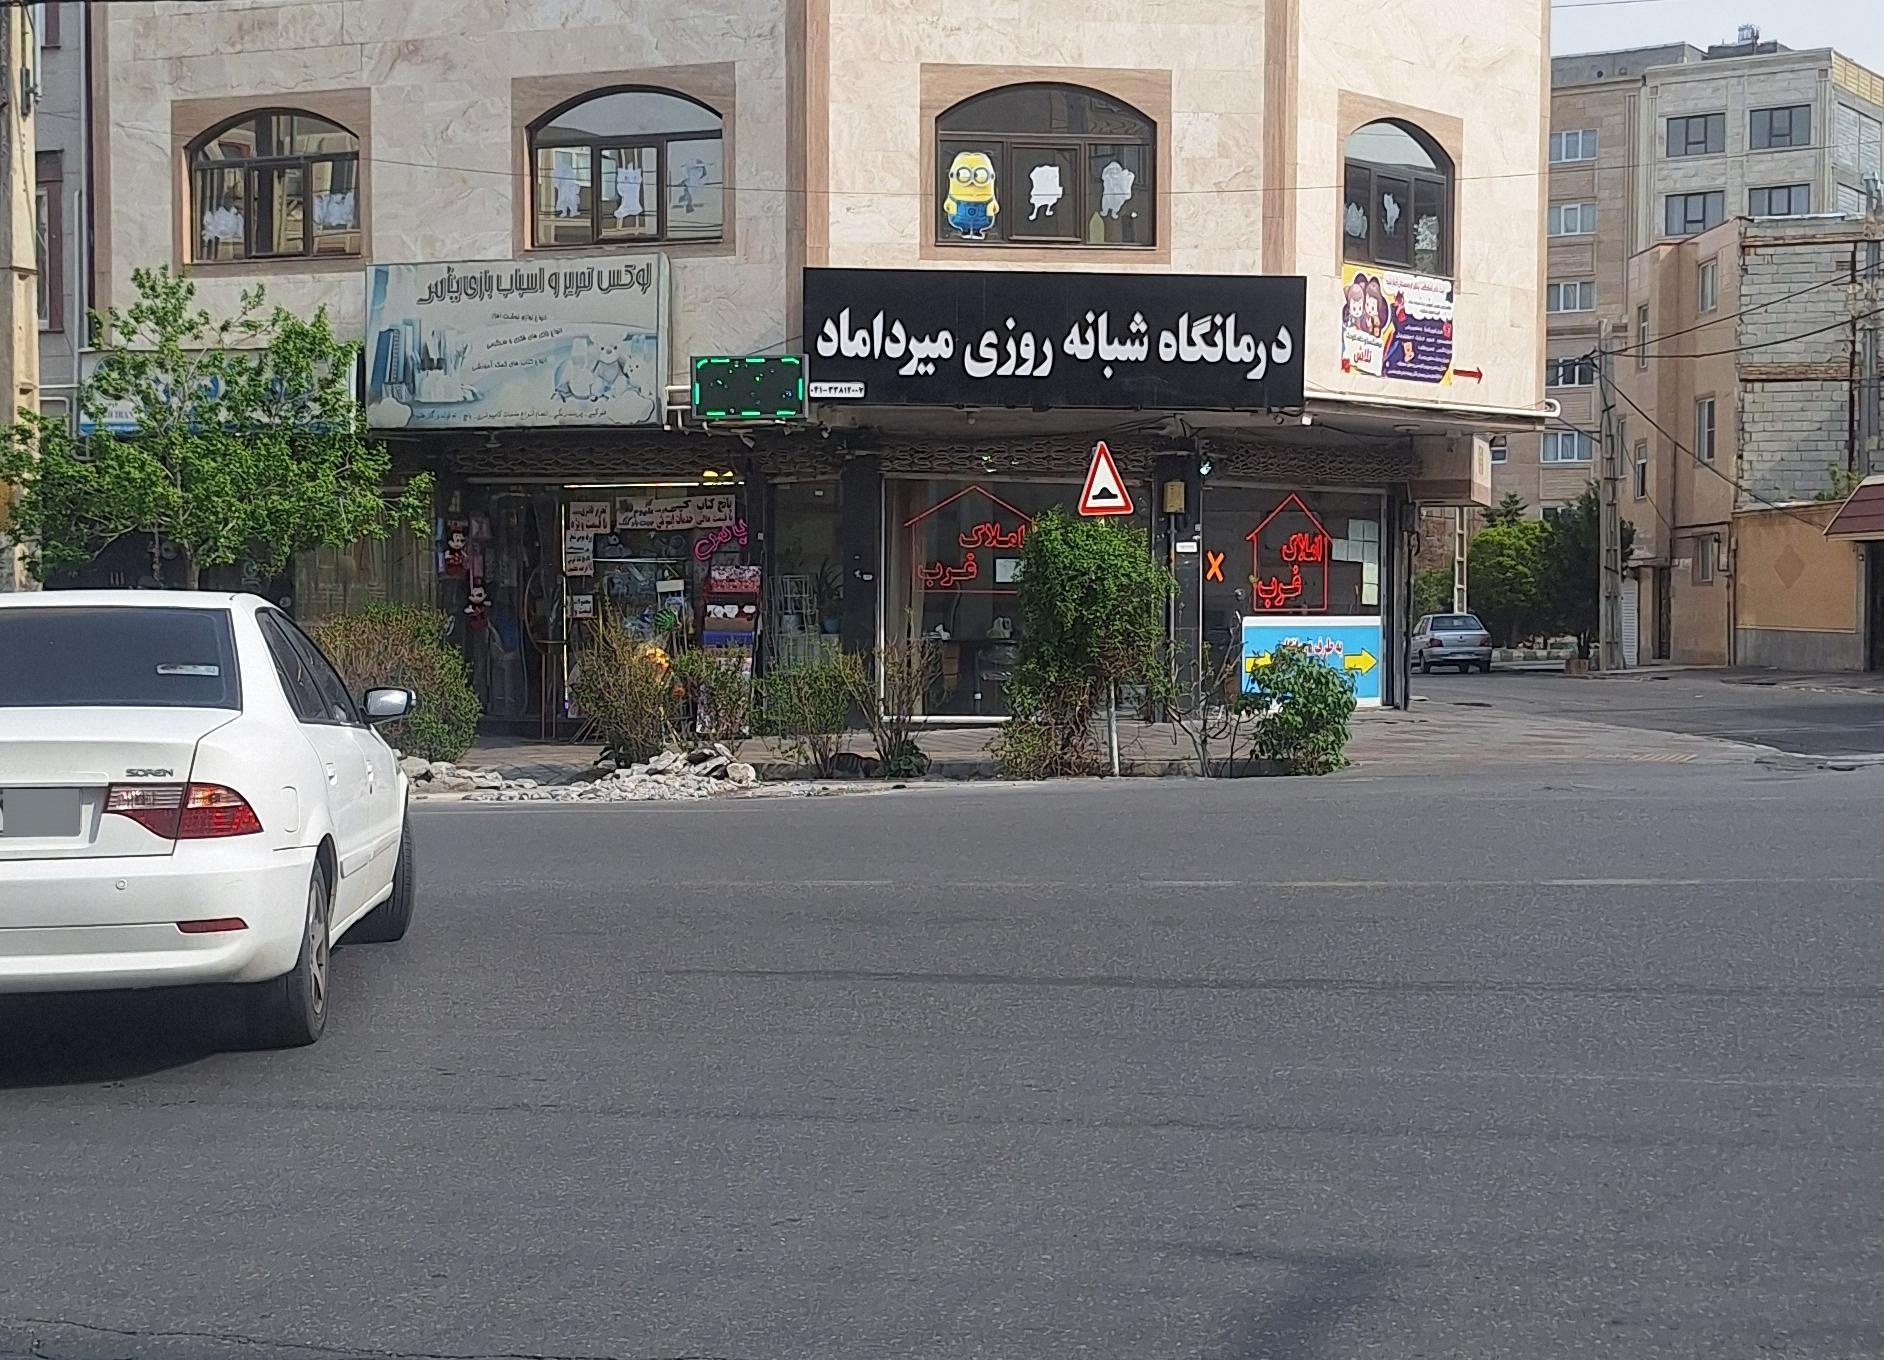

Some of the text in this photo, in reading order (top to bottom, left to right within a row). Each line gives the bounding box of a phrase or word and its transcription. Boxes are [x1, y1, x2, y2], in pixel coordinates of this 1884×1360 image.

[464, 269, 494, 300] بازی
[497, 267, 545, 297] اسباب
[547, 269, 560, 298] و
[563, 266, 594, 297] تحریر
[598, 262, 652, 296] لوکس
[816, 307, 1293, 379] درمانگاه شبانه روزی میرداماد
[959, 523, 1026, 548] املاک
[1282, 533, 1323, 562] املاک
[125, 768, 173, 777] SOREN
